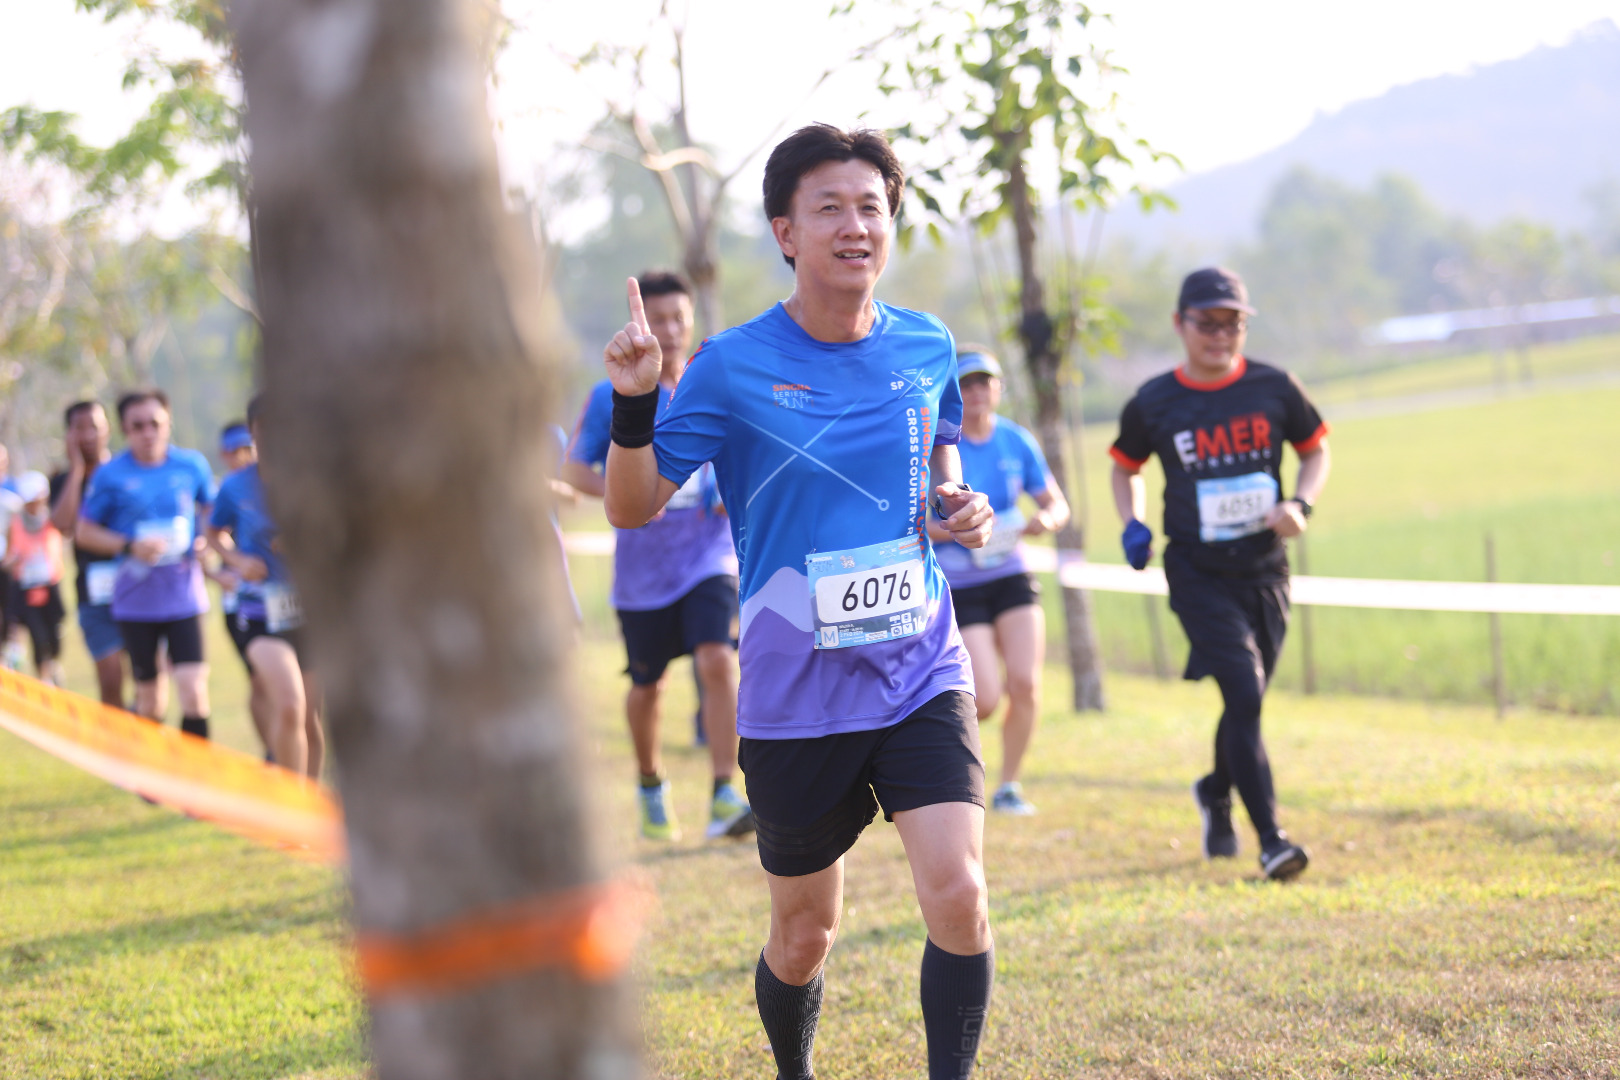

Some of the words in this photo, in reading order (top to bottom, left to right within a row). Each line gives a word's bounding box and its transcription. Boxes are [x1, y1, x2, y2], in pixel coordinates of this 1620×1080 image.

[890, 381, 904, 391] SP
[920, 377, 934, 387] XC
[906, 407, 919, 453] CROSS
[1173, 413, 1271, 464] EMER
[908, 456, 919, 524] COUNTRY
[842, 569, 911, 612] 6076
[823, 631, 836, 644] M
[951, 1005, 984, 1080] alenji
